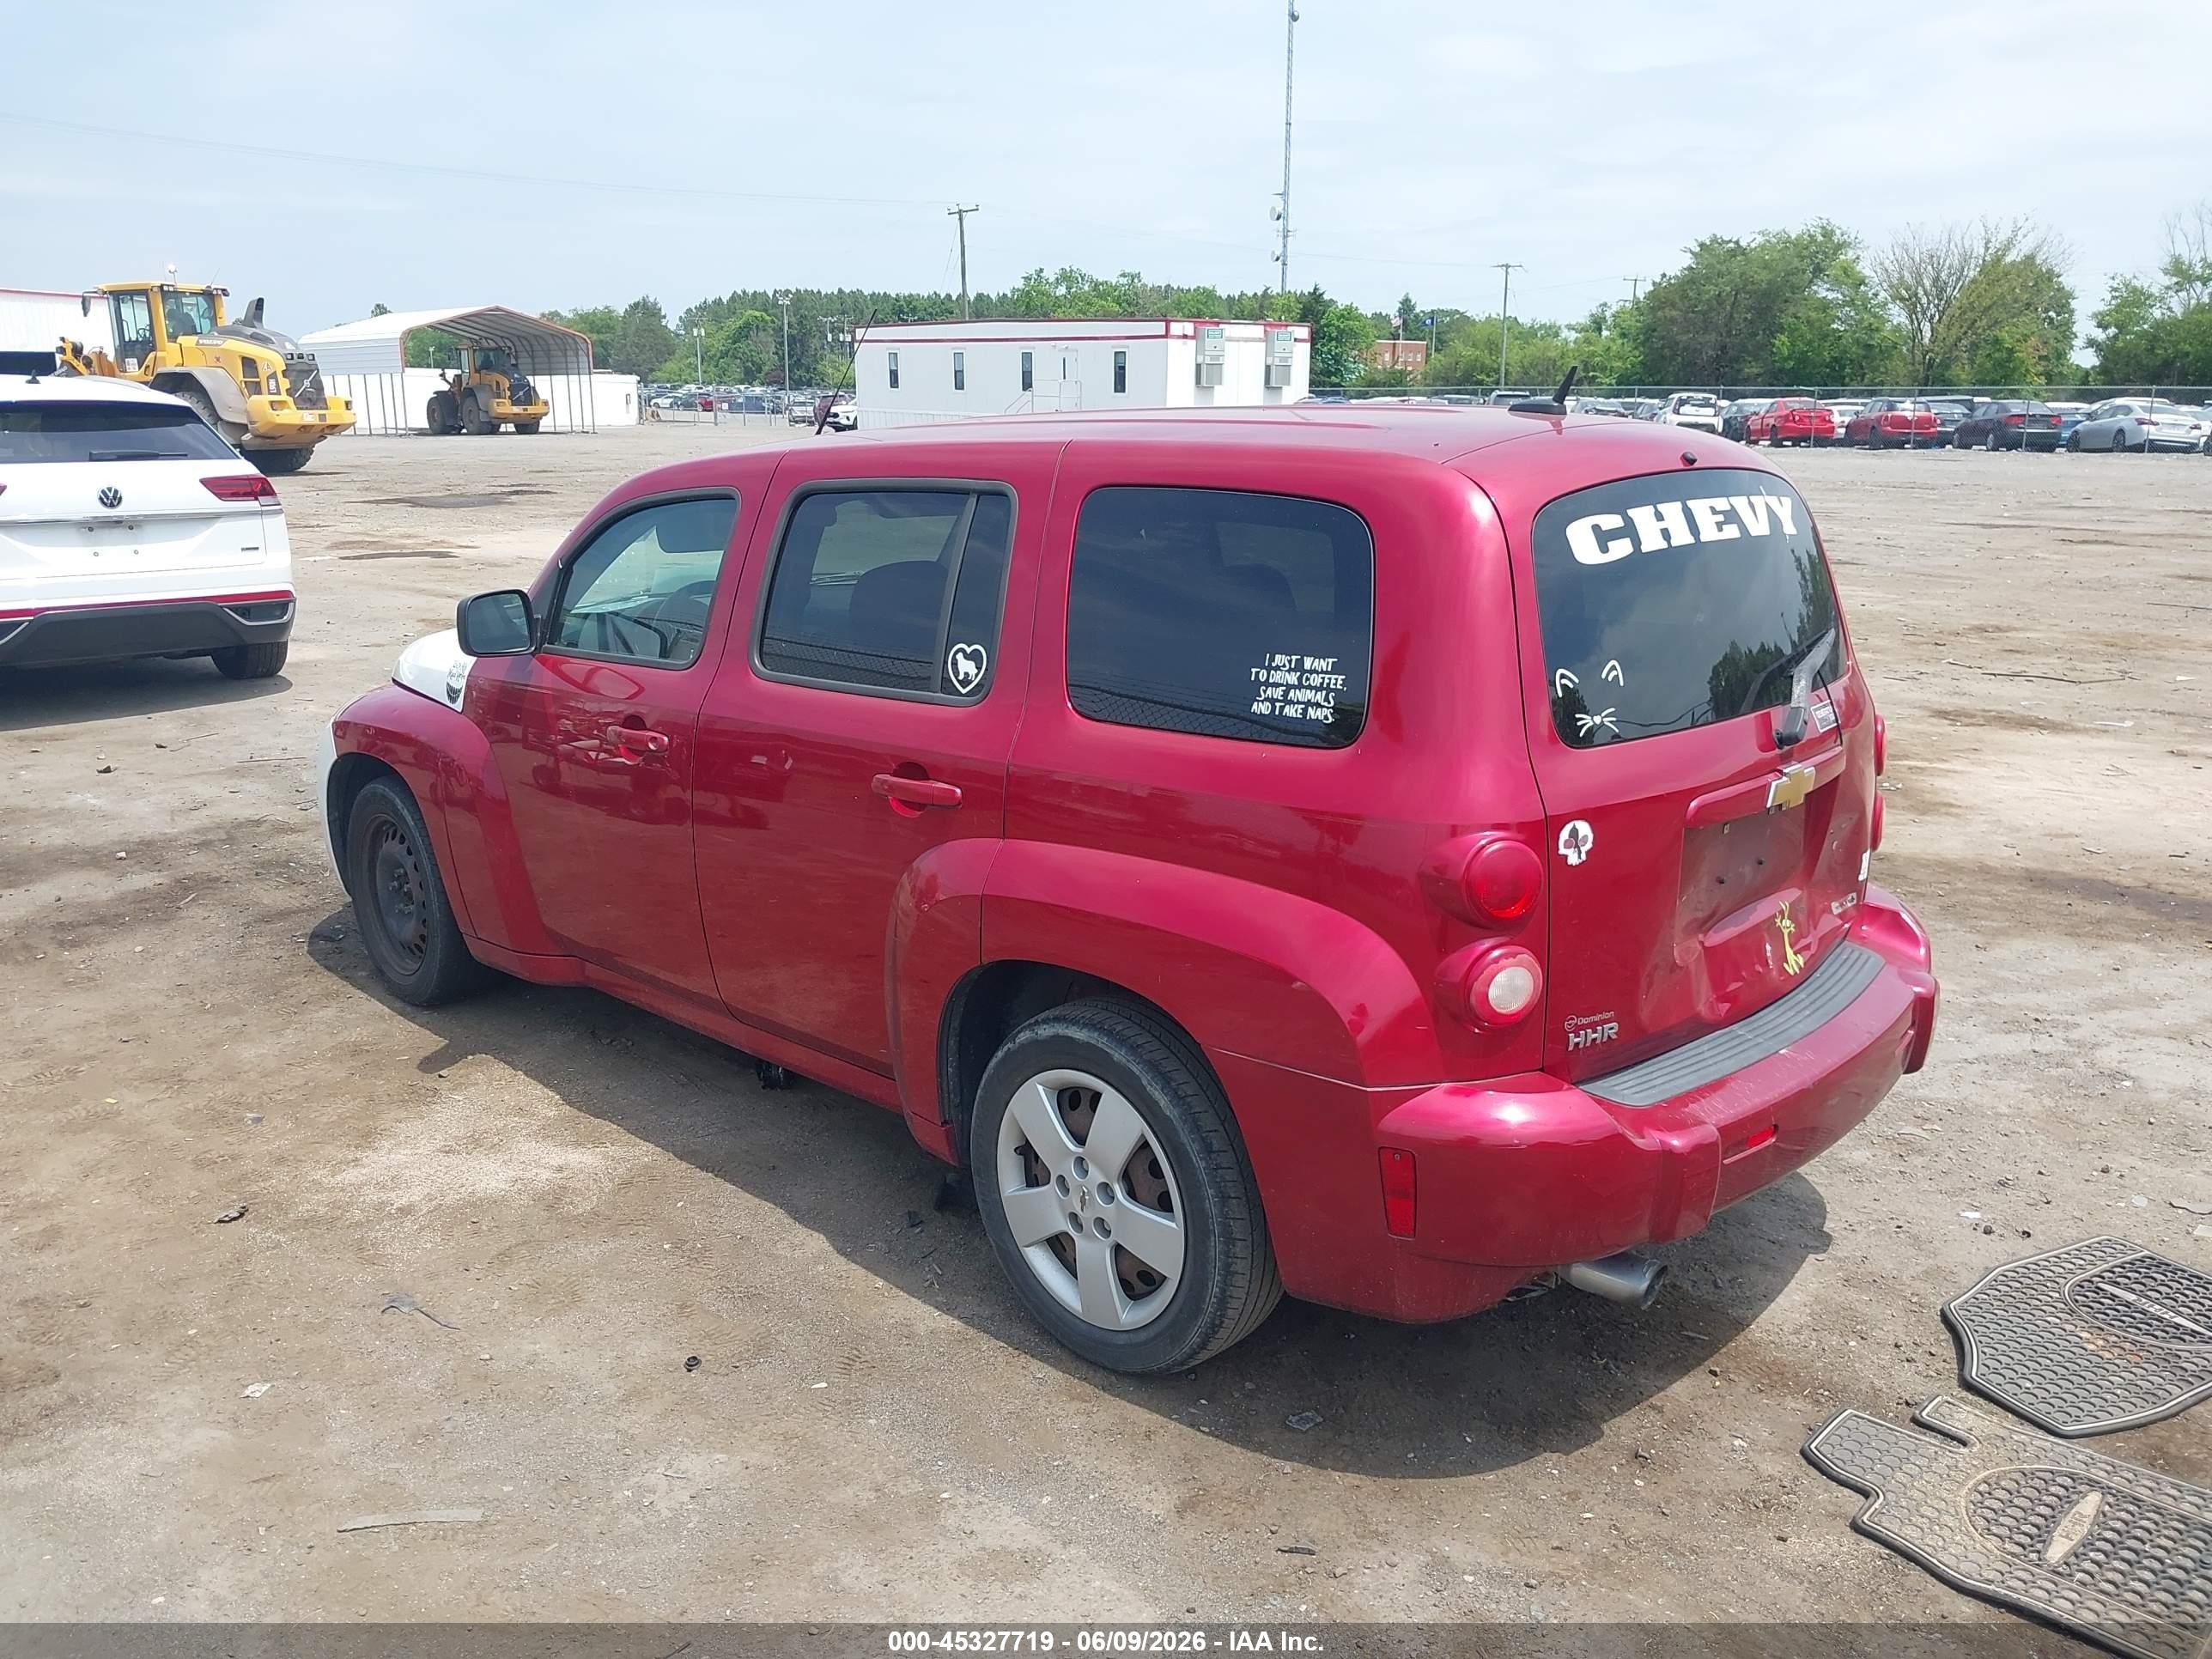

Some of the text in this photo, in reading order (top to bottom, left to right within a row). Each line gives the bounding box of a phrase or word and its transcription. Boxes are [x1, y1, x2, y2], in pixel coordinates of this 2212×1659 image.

[1565, 495, 1797, 565] CHEVY
[1265, 653, 1338, 672] I JUST WANT
[1250, 668, 1347, 692] TO DRINK COFFEE,
[1256, 686, 1335, 708] SAVE ANIMALS
[1250, 702, 1335, 724] AND TAKE NAPS.
[1577, 1011, 1614, 1025] Dominion
[1568, 1022, 1619, 1051] HHR
